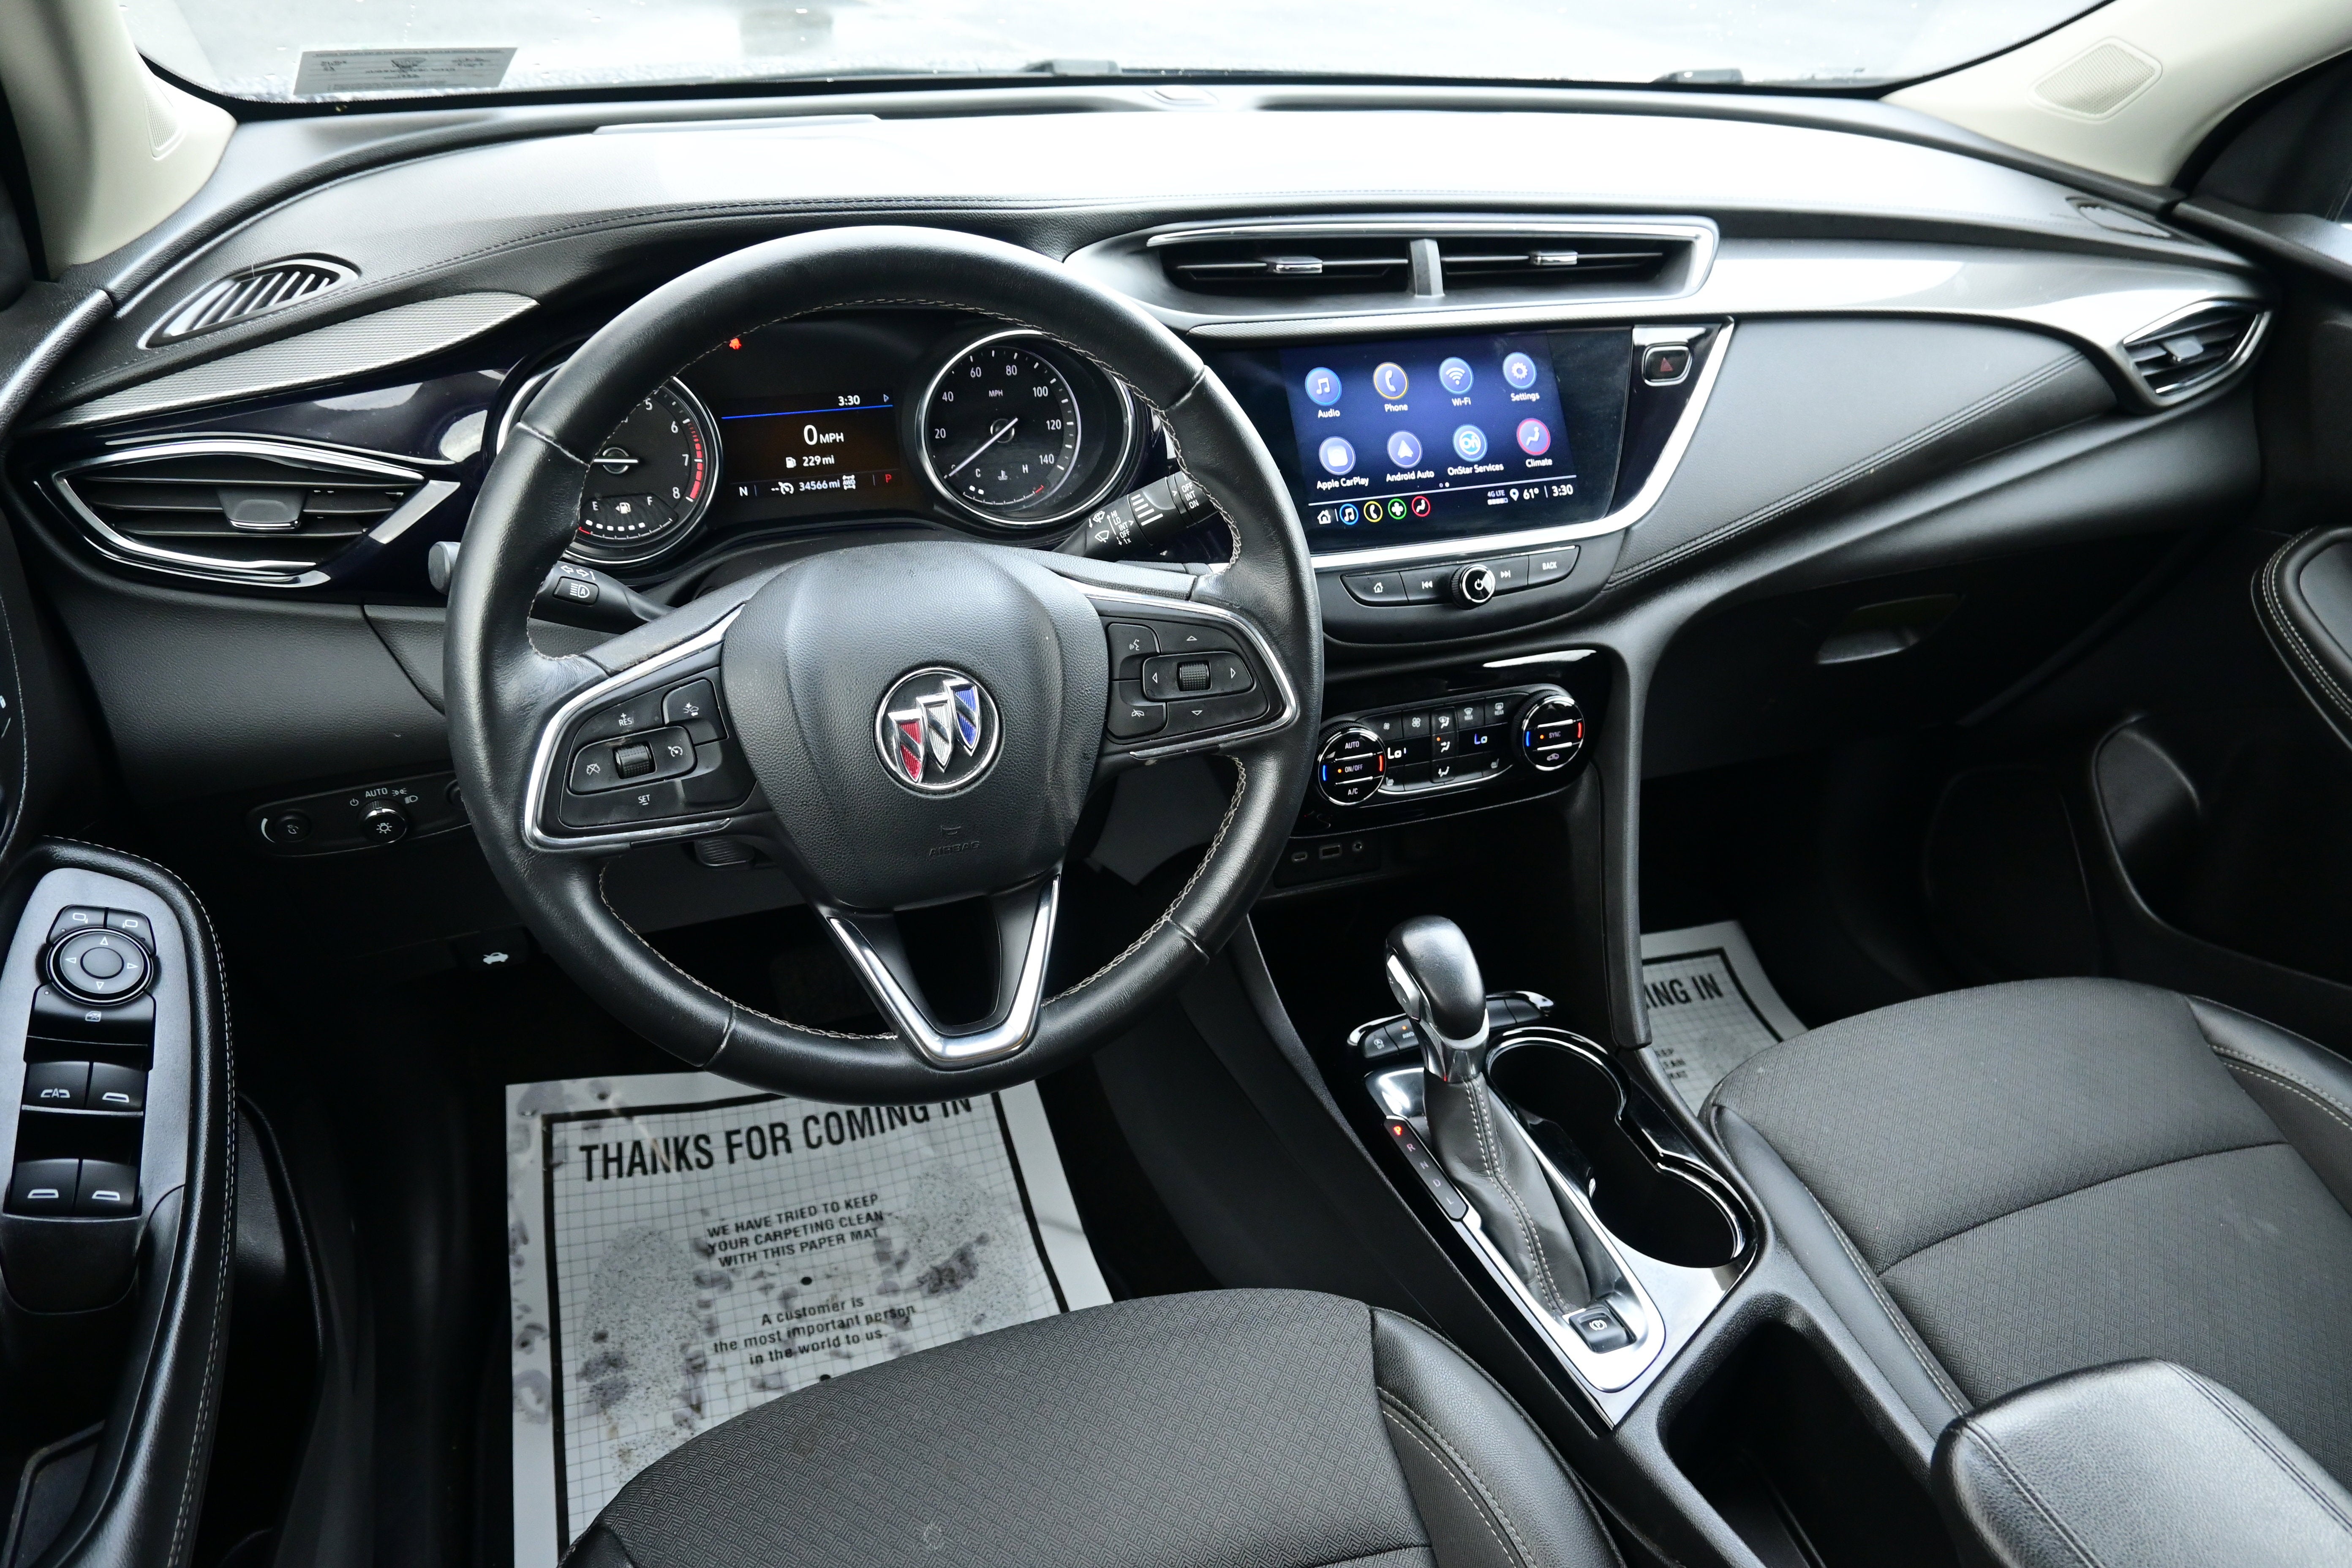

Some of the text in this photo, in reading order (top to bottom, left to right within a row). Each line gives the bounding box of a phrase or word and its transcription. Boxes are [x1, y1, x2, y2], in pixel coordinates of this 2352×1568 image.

[970, 367, 982, 377] 60
[1006, 365, 1017, 376] 80
[988, 389, 1003, 397] MPH
[1032, 386, 1048, 397] 100
[838, 395, 860, 406] 3:30
[942, 392, 954, 402] 40
[1451, 397, 1472, 406] Wi-Fi
[1510, 392, 1540, 402] Settings
[645, 400, 653, 410] 5
[1384, 403, 1408, 412] Phone
[1318, 408, 1340, 418] Audio
[671, 421, 678, 433] 6
[1046, 419, 1062, 430] 120
[803, 425, 844, 445] 0 MPH
[934, 428, 946, 438] 20
[682, 454, 689, 466] 7
[1039, 454, 1054, 464] 140
[1526, 458, 1552, 468] Climate
[975, 468, 981, 478] C
[1022, 464, 1029, 474] H
[1447, 463, 1504, 476] OnStar Services
[885, 474, 892, 483] P
[1386, 470, 1435, 482] Android Auto
[799, 480, 828, 491] 34566
[1181, 482, 1193, 493] OFF
[1317, 476, 1369, 490] Apple CarPlay
[672, 487, 681, 499] 8
[739, 487, 748, 496] N
[1184, 490, 1195, 501] INT
[1552, 484, 1573, 497] 3:30
[593, 501, 599, 511] E
[647, 496, 653, 506] F
[1189, 499, 1199, 509] ON
[1111, 510, 1118, 519] HI
[1113, 517, 1121, 525] LO
[1118, 521, 1128, 531] INT
[1119, 528, 1130, 538] OFF
[1542, 561, 1557, 570] BACK
[618, 718, 632, 727] RES
[1345, 740, 1359, 749] AUTO
[1345, 764, 1363, 773] ON/OFF
[365, 787, 388, 798] AUTO
[638, 795, 650, 803] SET
[929, 841, 980, 857] AIRBAG
[1691, 973, 1723, 1000] IN
[1394, 1125, 1402, 1136] P
[579, 1134, 714, 1181] THANKS
[725, 1122, 792, 1164] FOR
[1406, 1143, 1416, 1152] R
[1420, 1161, 1429, 1169] N
[1433, 1179, 1441, 1187] D
[707, 1193, 878, 1238] WE HAVE TRIED TO KEEP
[708, 1210, 884, 1255] YOUR CARPETING CLEAN
[719, 1228, 879, 1267] WITH THIS PAPER MAT
[761, 1297, 864, 1326] A customer is
[713, 1304, 916, 1353] the most important person
[749, 1328, 887, 1365] in the world to us.
